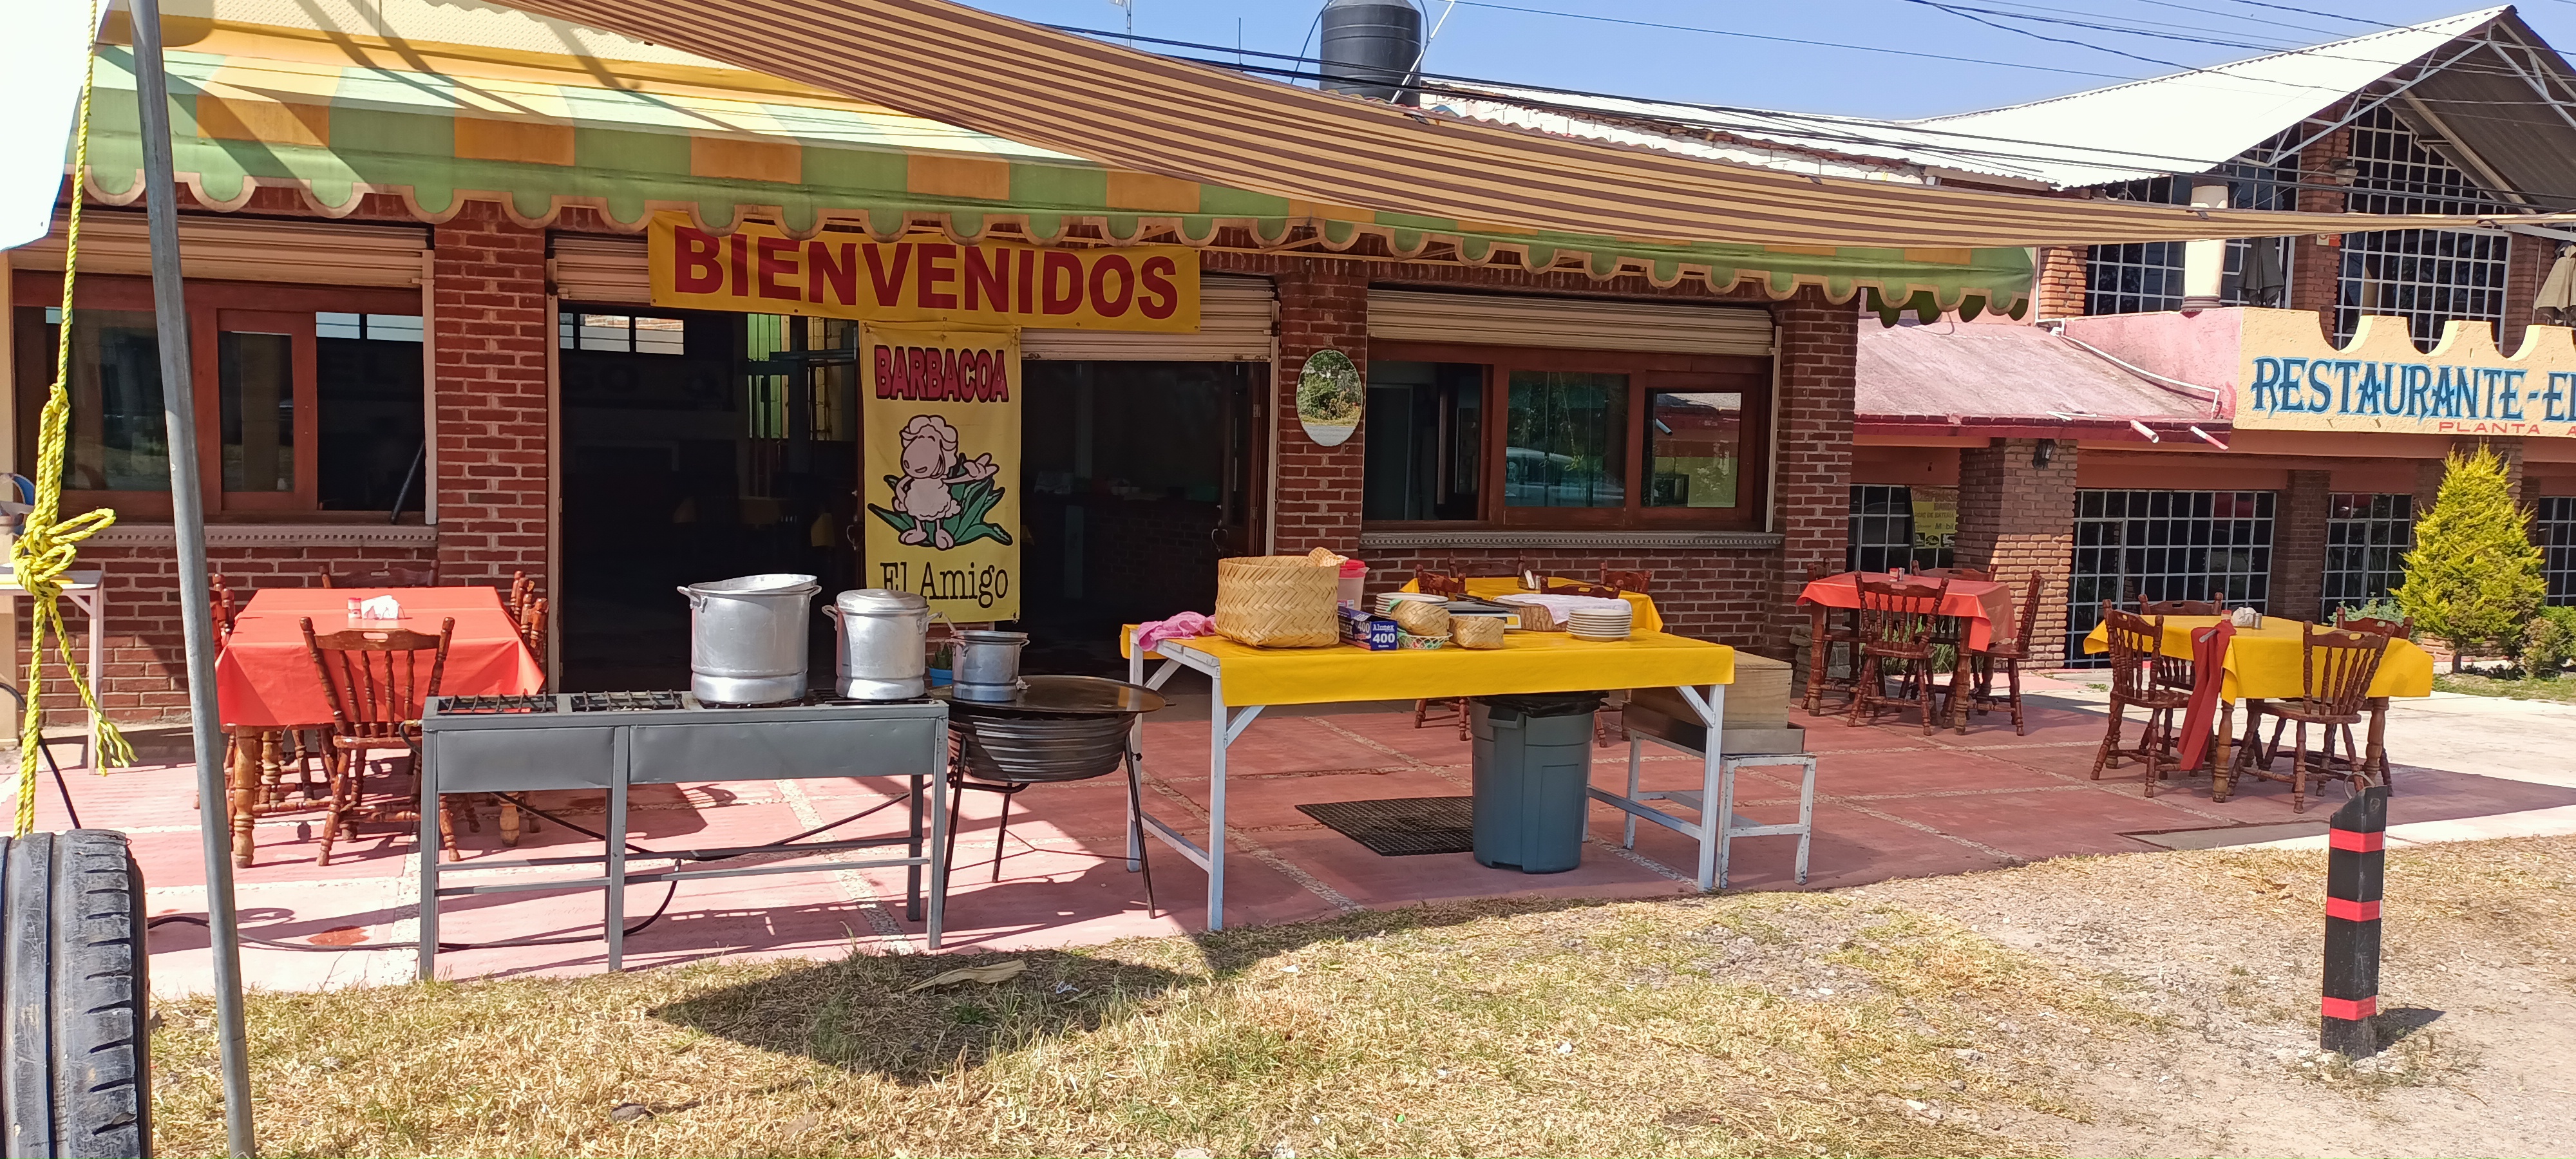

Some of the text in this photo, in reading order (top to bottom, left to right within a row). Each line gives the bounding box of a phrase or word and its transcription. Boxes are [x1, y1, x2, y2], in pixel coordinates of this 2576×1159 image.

[674, 225, 1179, 319] BIENVENIDOS
[873, 344, 1009, 402] BARBACOA
[2438, 422, 2541, 435] PLANTA
[880, 561, 1009, 607] El Amigo
[1358, 621, 1370, 634] 400
[1372, 633, 1396, 643] 400
